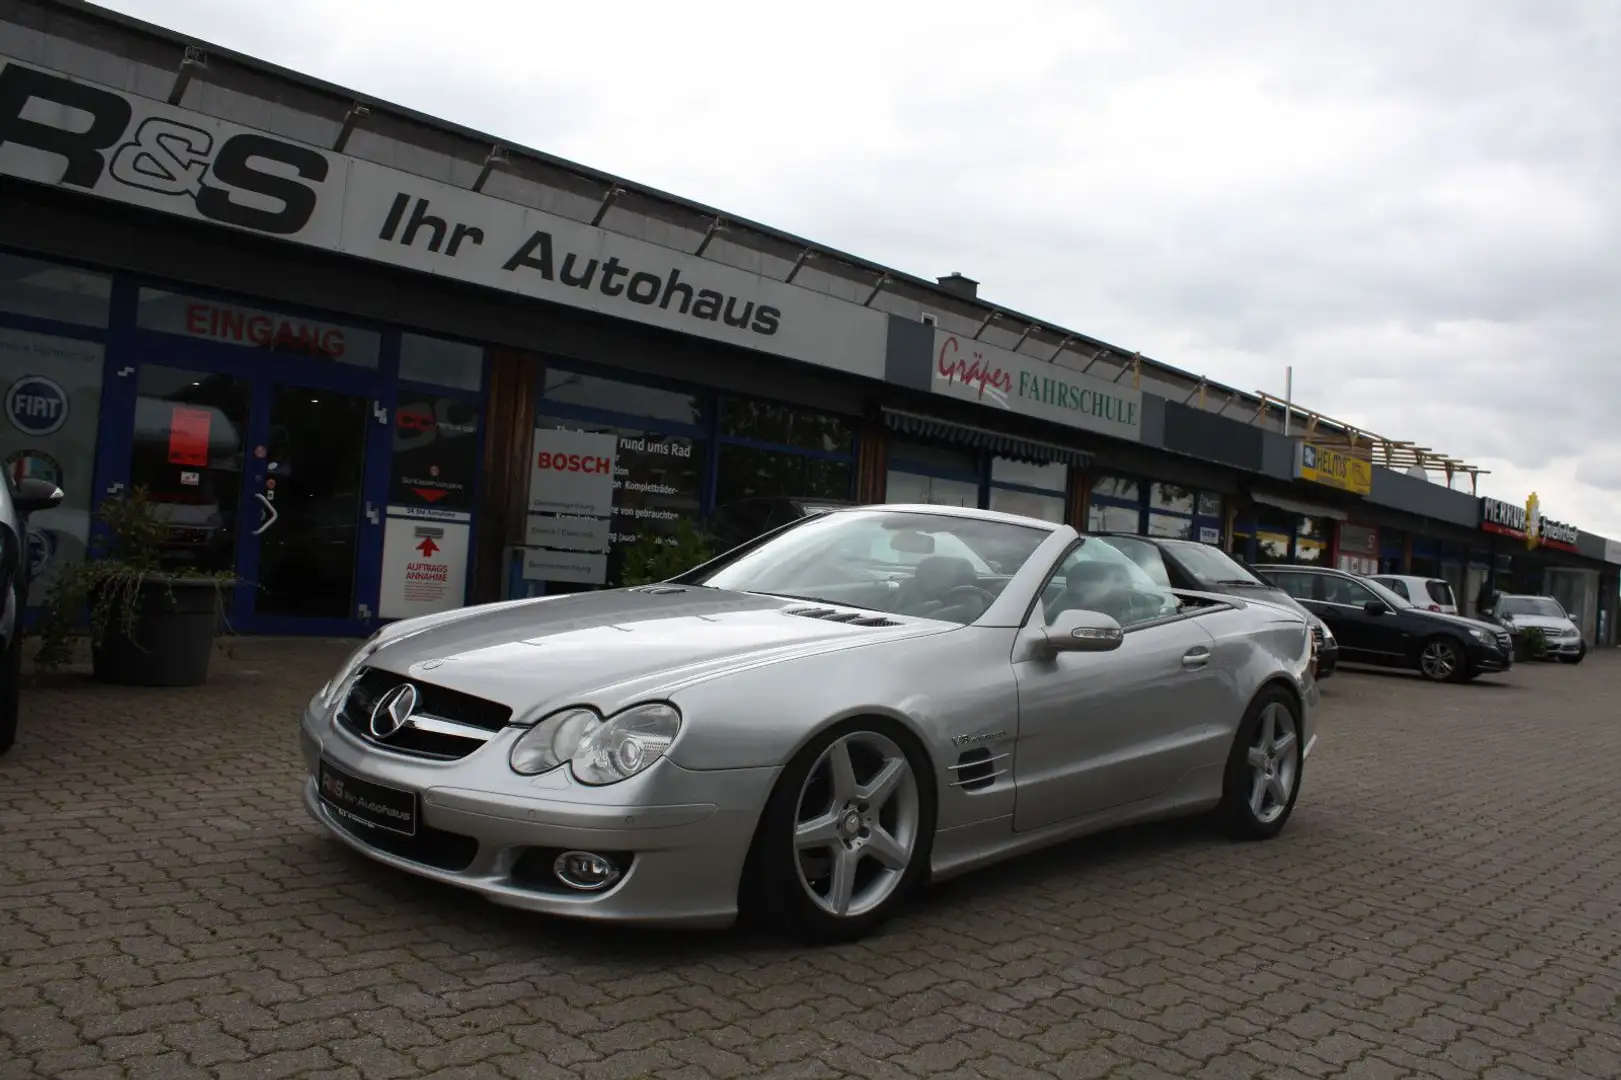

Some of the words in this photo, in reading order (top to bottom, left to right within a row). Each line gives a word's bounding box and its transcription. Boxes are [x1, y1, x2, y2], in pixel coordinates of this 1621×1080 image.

[0, 63, 328, 235] R&S
[378, 192, 484, 257] Ihr
[502, 230, 781, 335] Autohaus
[186, 303, 346, 358] EINGANG
[938, 336, 1013, 400] Gräper
[1019, 371, 1137, 427] FAHRSCHULE
[14, 393, 60, 419] FIAT
[619, 437, 645, 451] rund
[647, 442, 669, 455] ums
[671, 443, 692, 458] Rad
[537, 452, 611, 475] BOSCH
[620, 507, 634, 516] von
[1485, 497, 1526, 530] MERKUR
[406, 572, 447, 582] ANNAHME
[407, 562, 448, 573] AUFTRAGS
[357, 796, 413, 821] Autohaus
